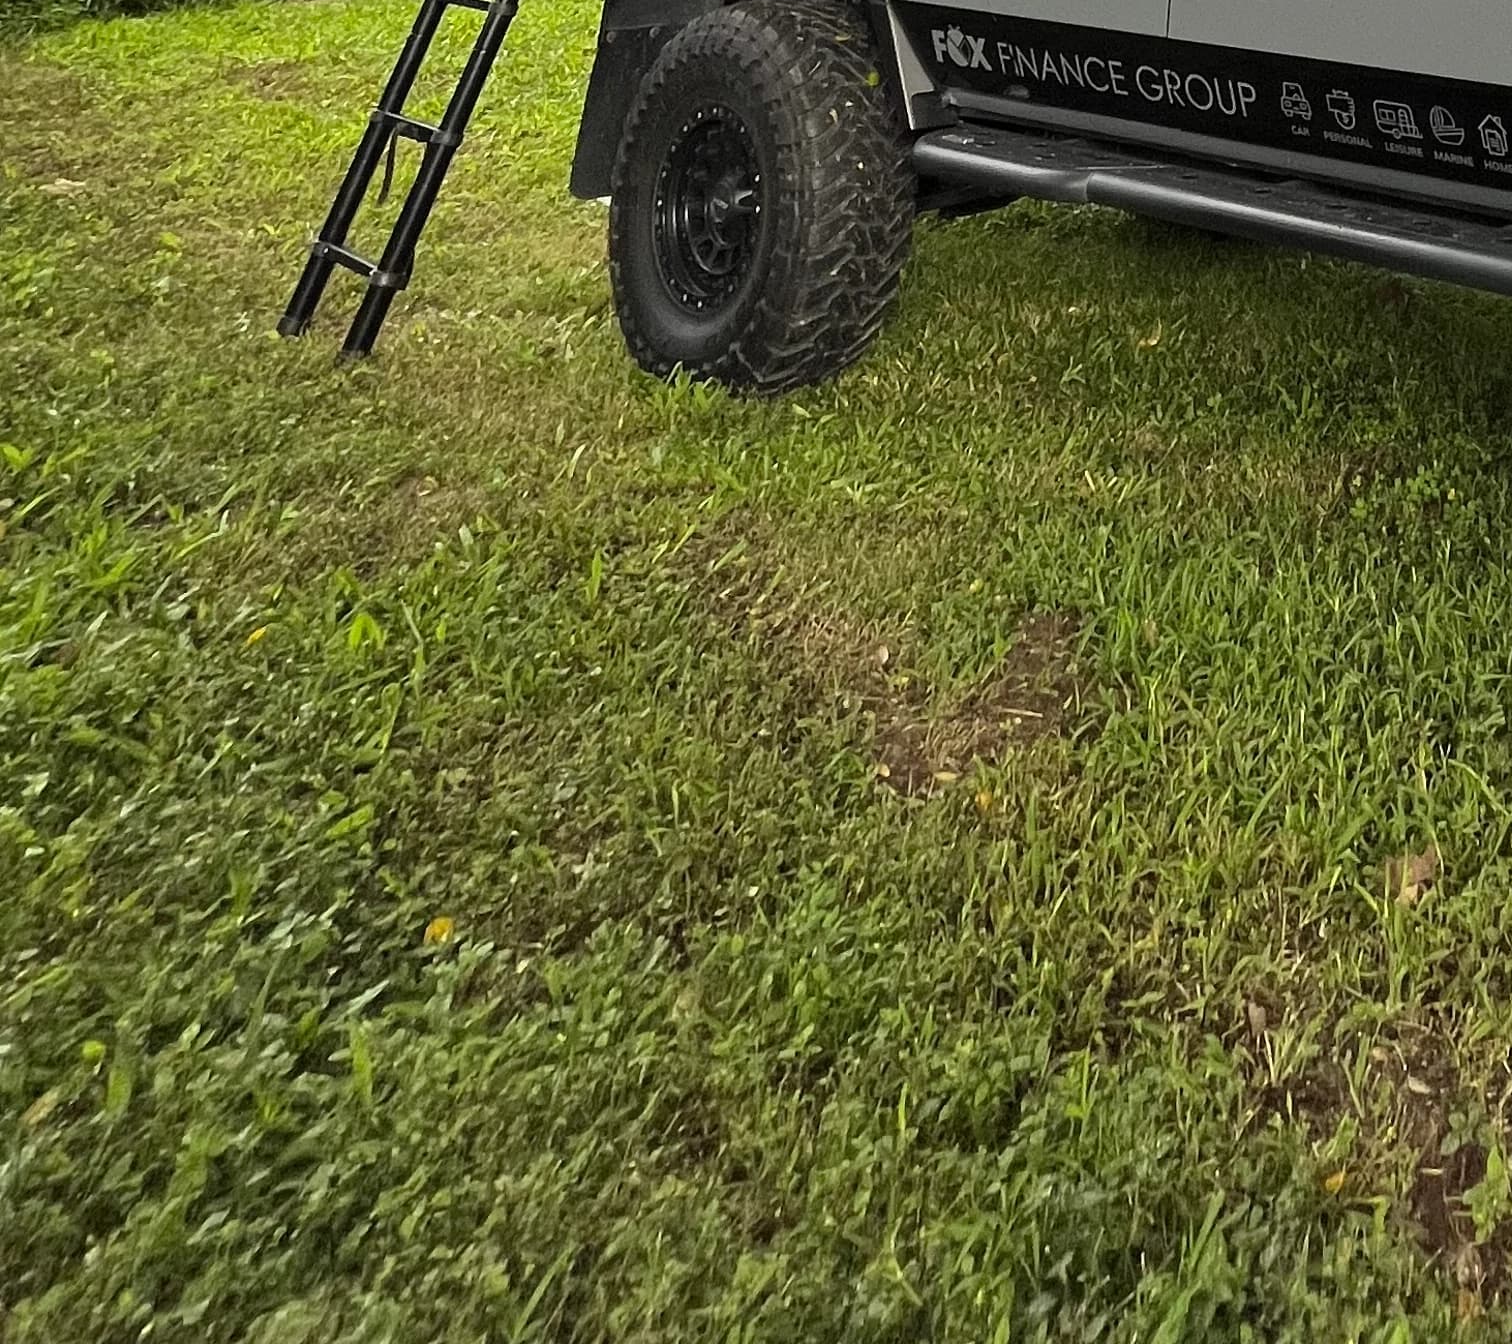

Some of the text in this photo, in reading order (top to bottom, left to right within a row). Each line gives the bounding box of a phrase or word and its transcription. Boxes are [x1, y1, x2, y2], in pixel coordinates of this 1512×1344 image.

[931, 25, 1257, 118] FOX FINANCE GROUP
[1291, 124, 1311, 137] CAR
[1323, 130, 1373, 149] PERSONAL
[1385, 142, 1424, 159] LEISURE
[1434, 150, 1475, 168] MARINE
